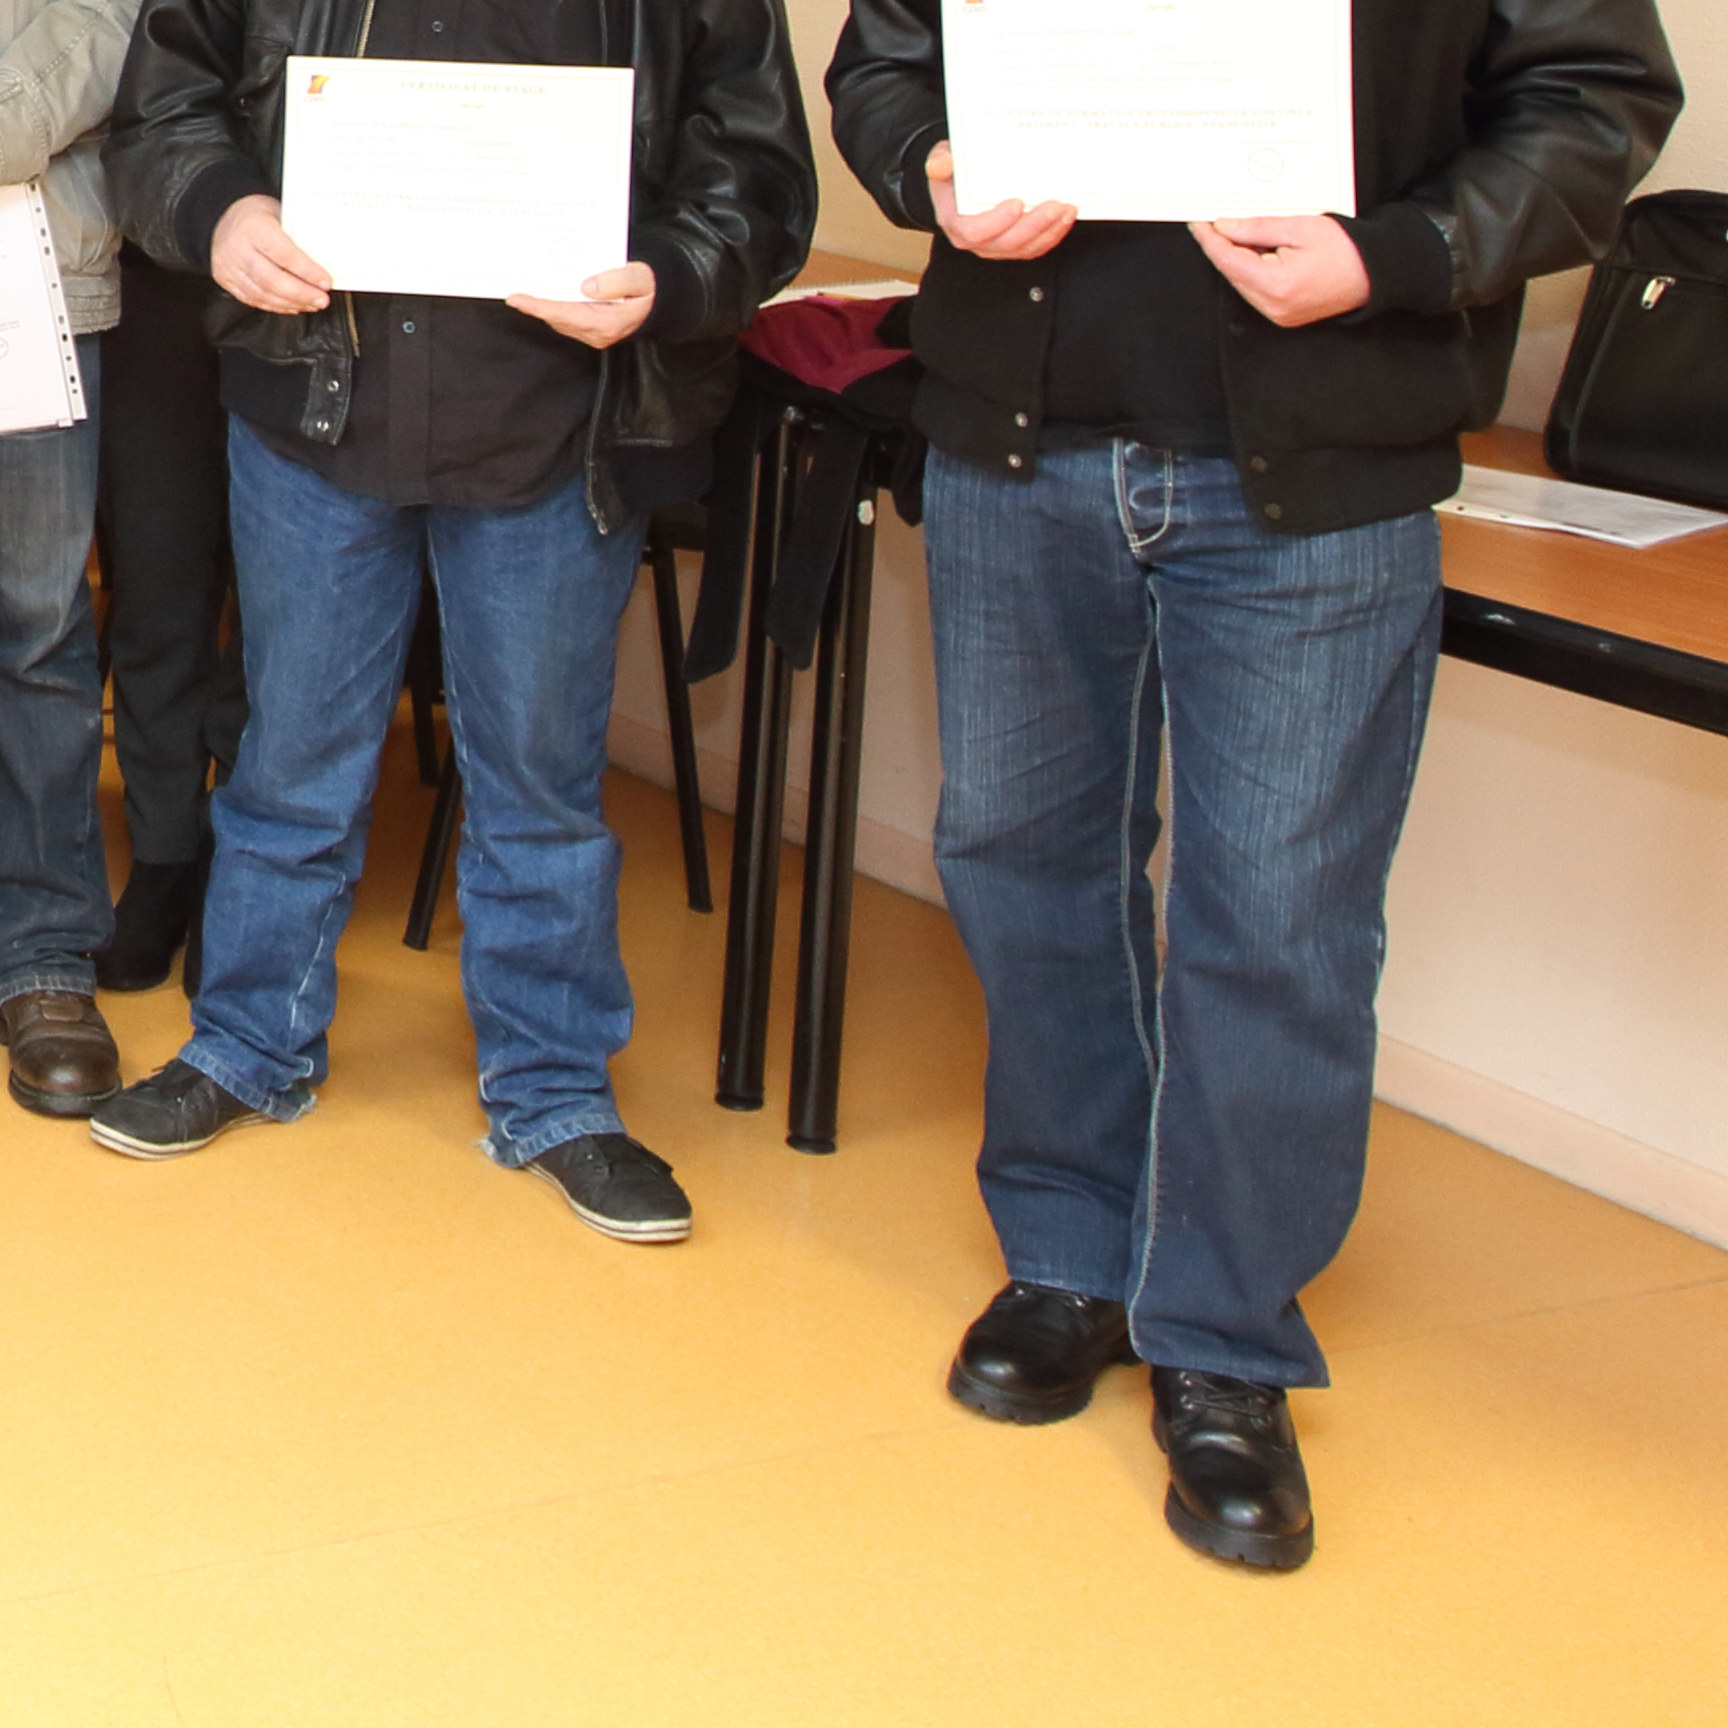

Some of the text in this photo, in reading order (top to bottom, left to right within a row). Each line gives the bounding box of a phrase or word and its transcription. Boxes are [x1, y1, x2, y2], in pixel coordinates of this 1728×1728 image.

[400, 80, 547, 95] CERTIFICAT DE STAGE
